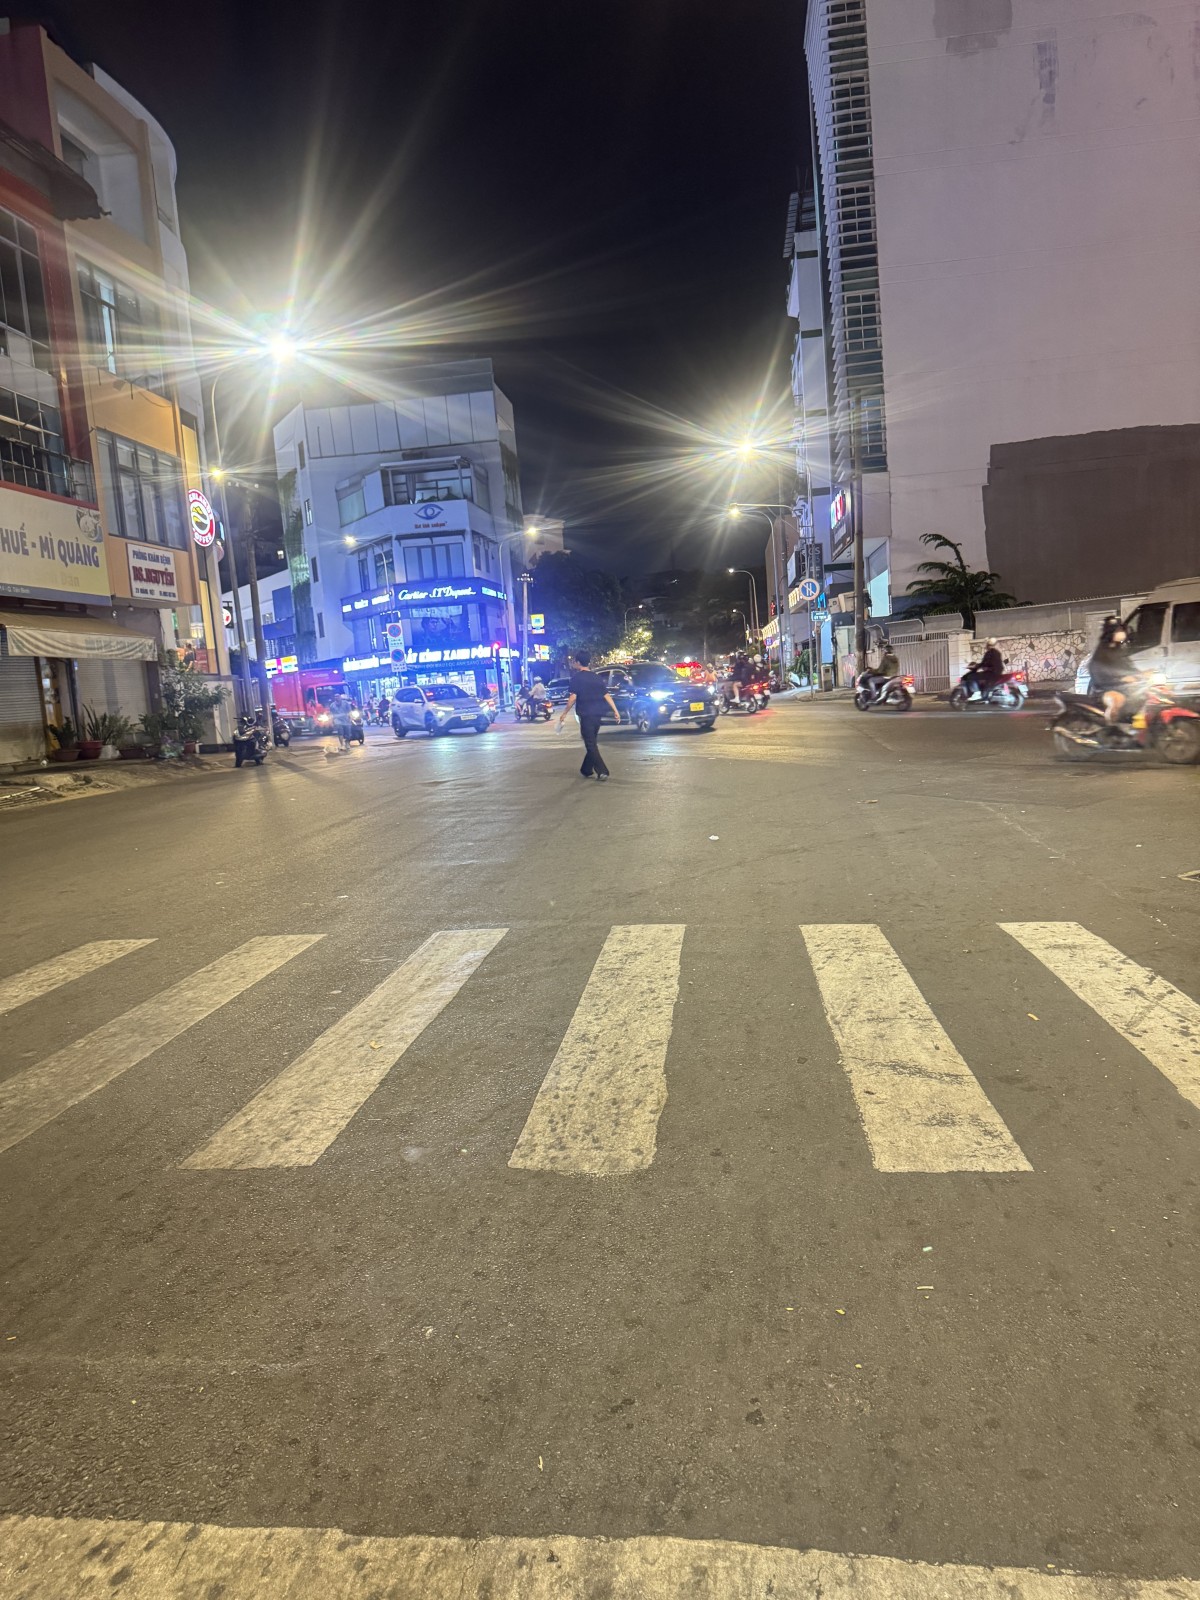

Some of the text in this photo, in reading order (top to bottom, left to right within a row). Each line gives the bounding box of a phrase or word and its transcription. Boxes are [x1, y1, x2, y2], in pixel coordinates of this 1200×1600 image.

[0, 522, 29, 556] HUẾ
[39, 532, 55, 560] MÌ
[57, 537, 100, 568] QUẢNG
[398, 589, 428, 600] Cartier
